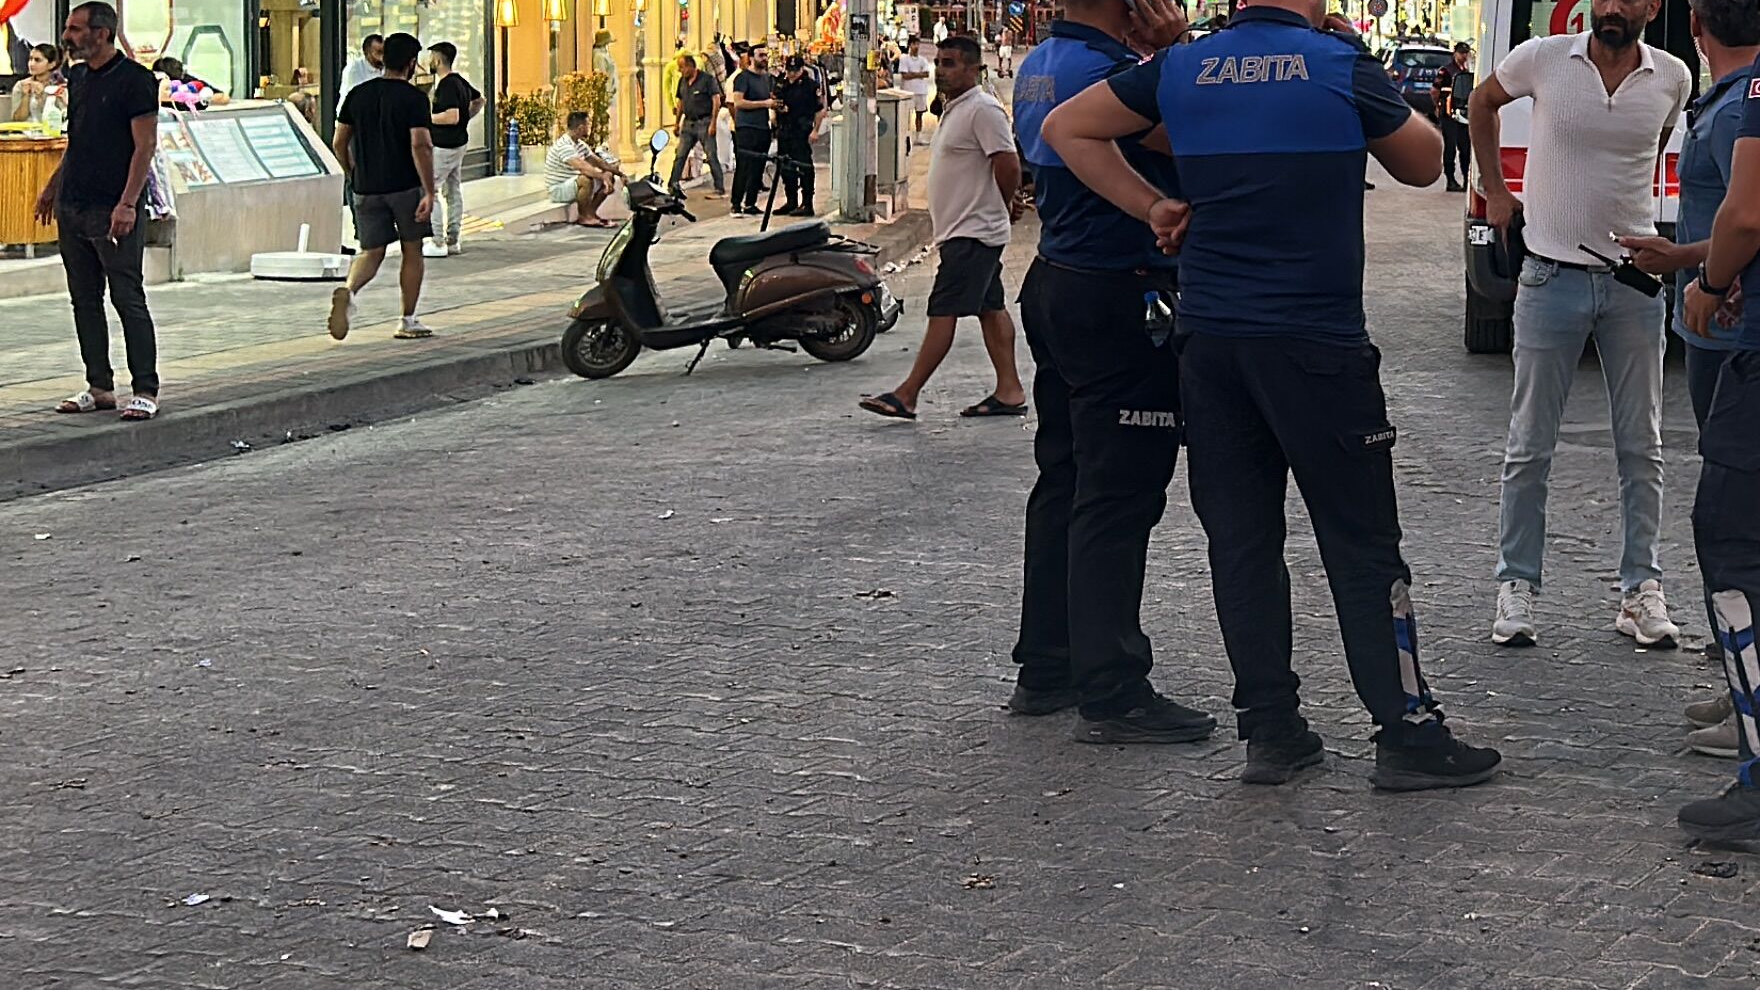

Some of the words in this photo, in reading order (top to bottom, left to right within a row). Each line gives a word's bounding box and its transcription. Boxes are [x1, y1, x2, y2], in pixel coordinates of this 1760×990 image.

[1196, 54, 1310, 85] ZABITA
[1119, 409, 1176, 428] ZABITA
[1364, 430, 1396, 445] ZABITA
